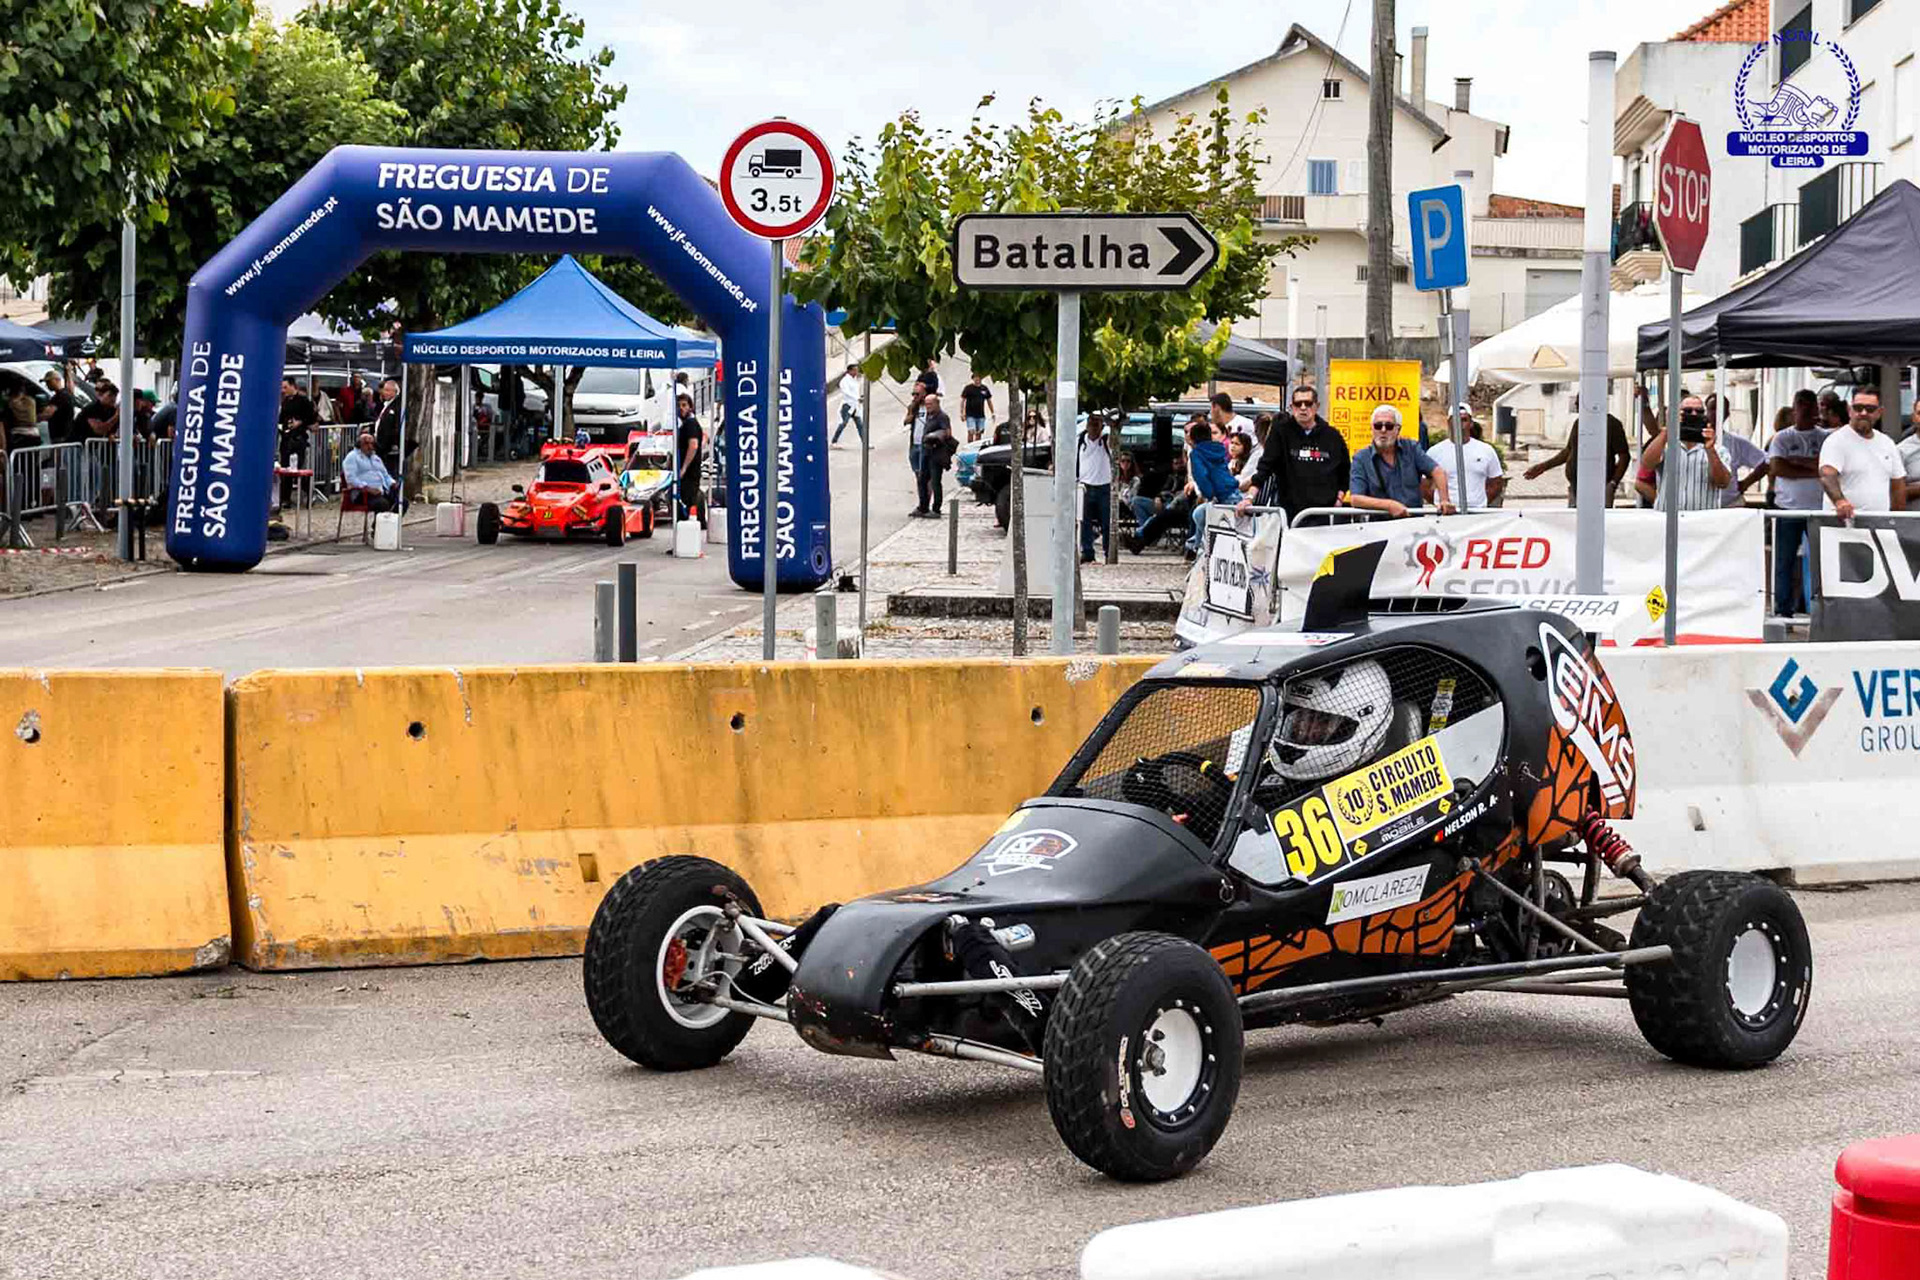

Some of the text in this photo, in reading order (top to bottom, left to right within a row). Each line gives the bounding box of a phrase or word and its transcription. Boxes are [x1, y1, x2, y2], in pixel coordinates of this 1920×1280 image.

[378, 163, 610, 193] FREGUESIA DE
[750, 188, 802, 213] 3,5t
[1659, 162, 1710, 224] STOP
[376, 198, 598, 234] SÃO MAMEDE
[1420, 199, 1452, 280] P
[225, 196, 339, 297] www.jf-saomamede.pt
[646, 205, 758, 312] www.jf-saomamede.pt
[974, 234, 1150, 269] Batalha
[412, 343, 666, 360] NÚCLEO DESPORTOS MOTORIZADOS DE LEIRIA
[1335, 386, 1410, 401] REIXIDA
[175, 341, 211, 534] FREGUESIA DE
[200, 353, 245, 538] SÃO MAMEDE
[777, 368, 795, 494] MAMEDE
[737, 360, 760, 560] FREGUESIA DE
[1461, 537, 1551, 569] RED
[1369, 745, 1436, 792] CIRCUITO
[1376, 767, 1443, 814] S. MAMEDE
[1274, 796, 1343, 877] 36
[1444, 807, 1478, 837] NELSON
